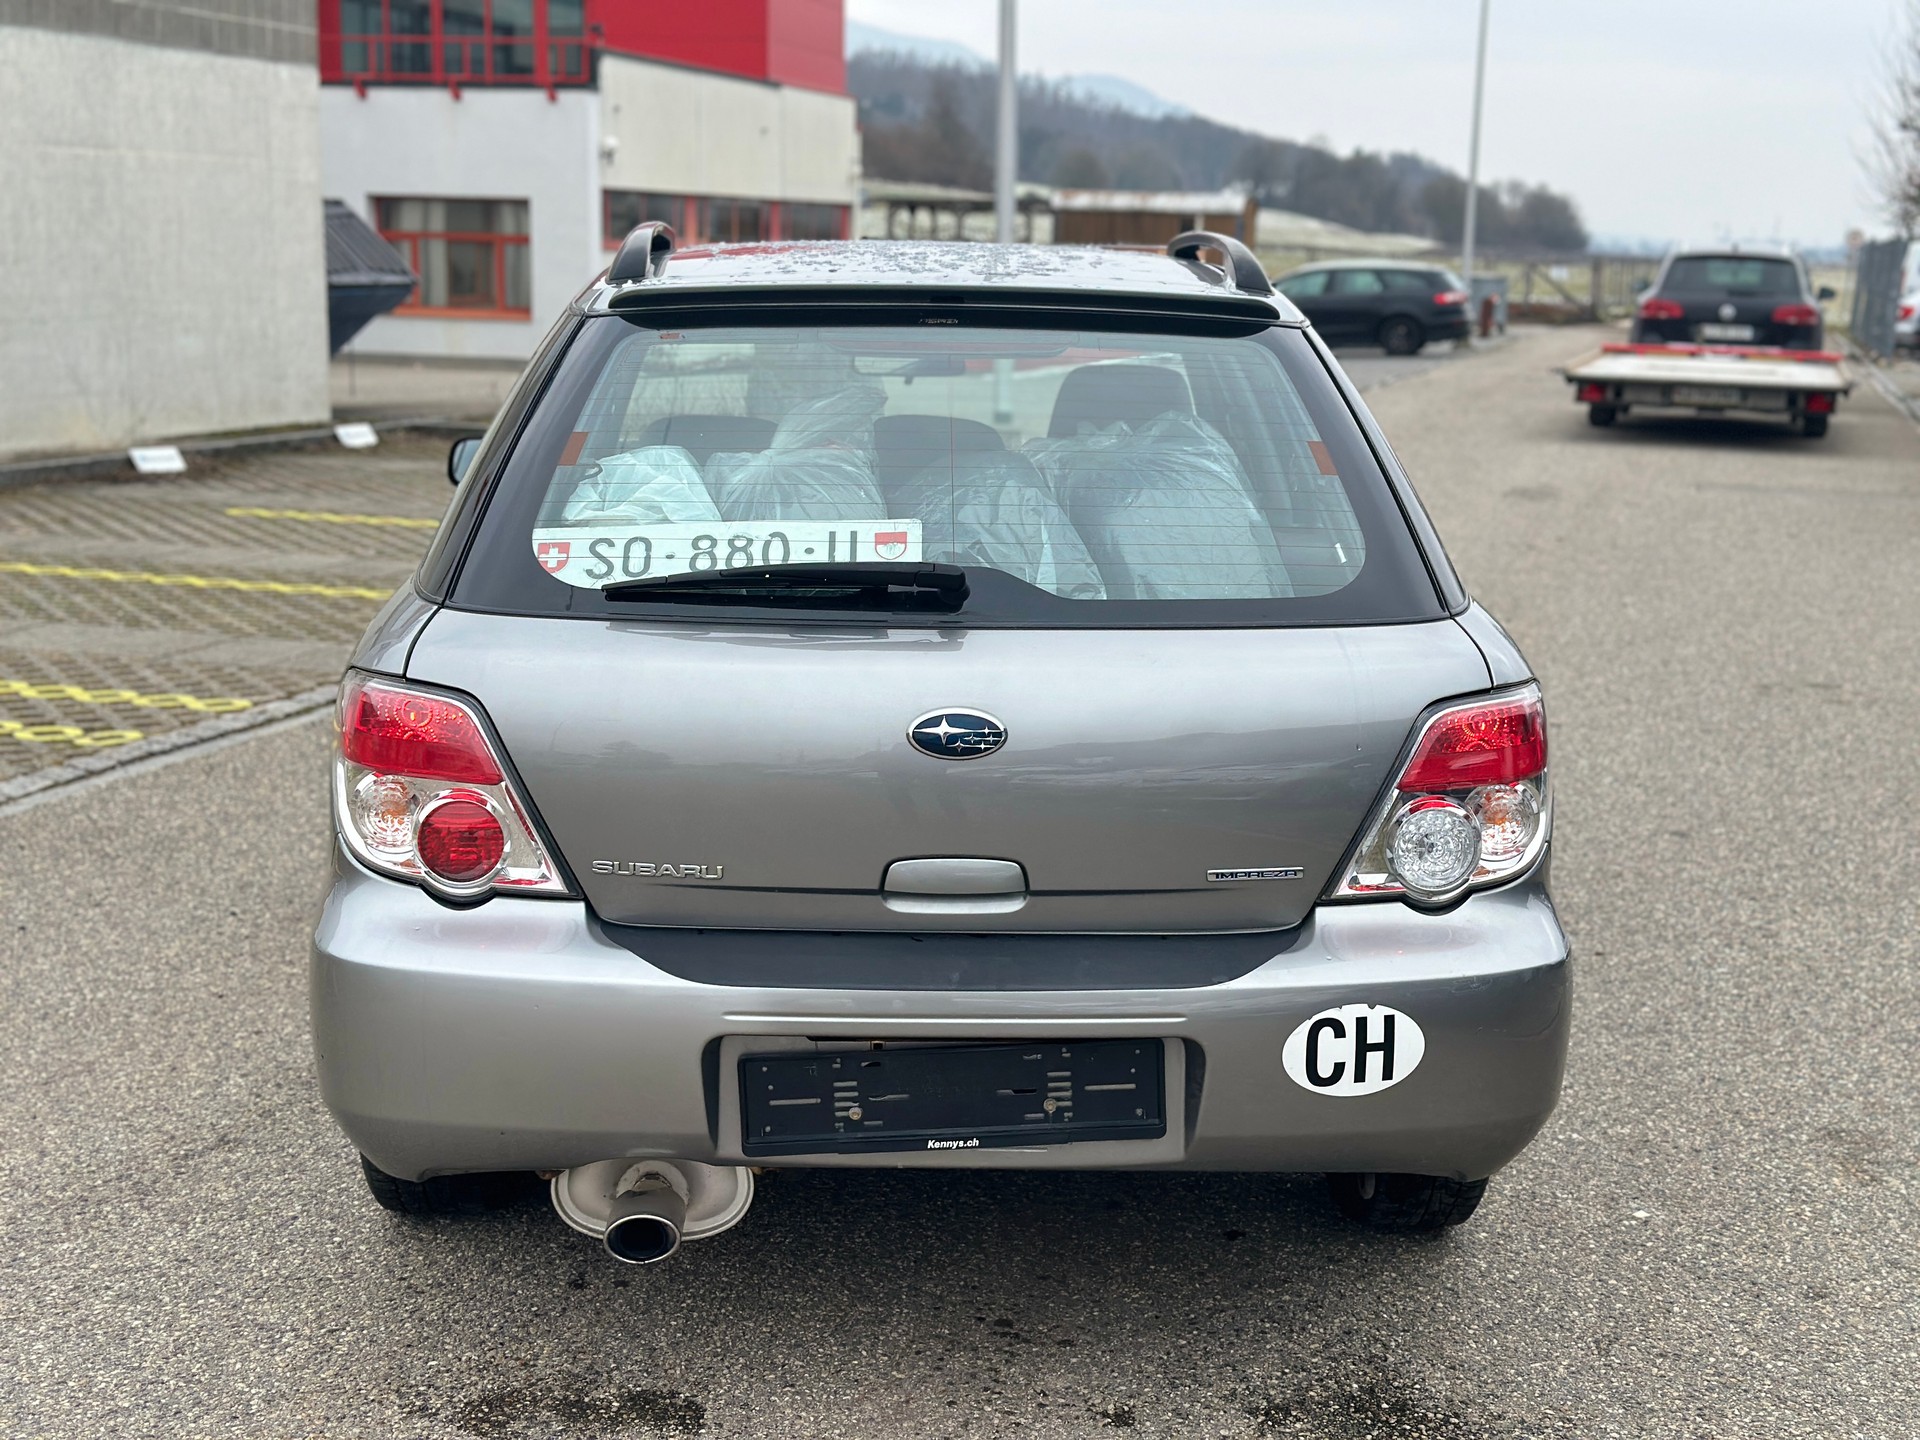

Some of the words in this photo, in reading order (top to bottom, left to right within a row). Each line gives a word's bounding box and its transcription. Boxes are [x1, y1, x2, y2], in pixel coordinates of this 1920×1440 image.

[585, 536, 652, 580] SO
[592, 860, 724, 880] SUBARU
[1215, 870, 1298, 879] IMPREZA
[1305, 1014, 1395, 1088] CH
[927, 1138, 980, 1149] Kennys.ch
